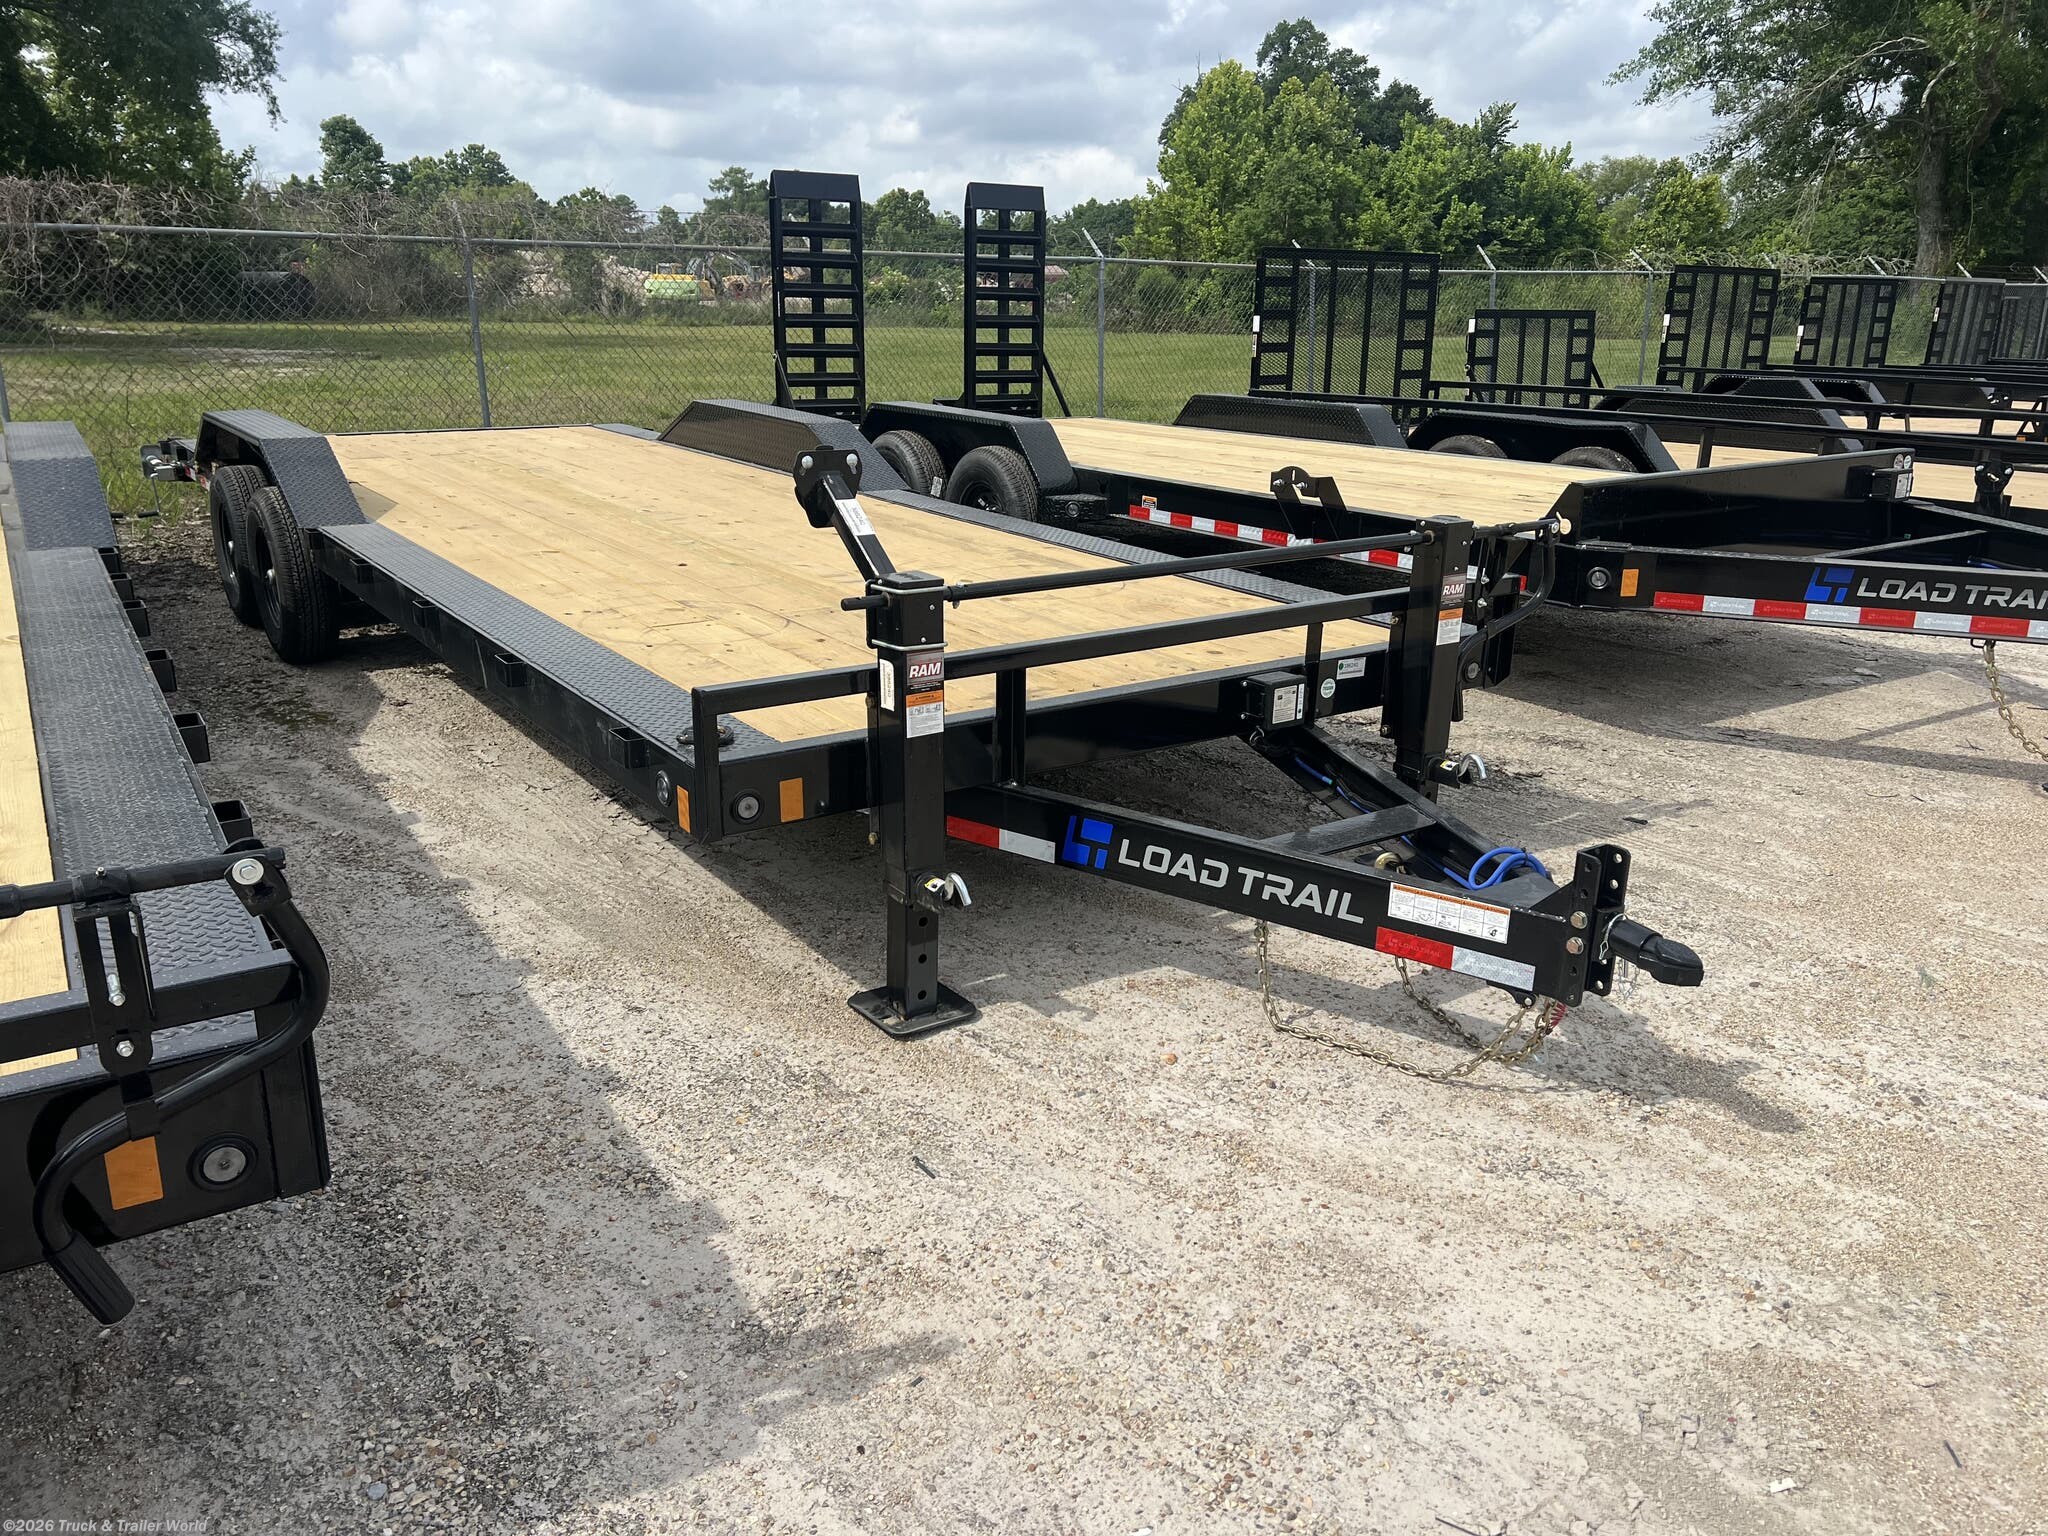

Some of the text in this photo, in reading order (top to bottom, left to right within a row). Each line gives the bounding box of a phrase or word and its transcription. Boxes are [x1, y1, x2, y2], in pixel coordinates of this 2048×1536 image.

[1442, 583, 1464, 596] RAM
[1857, 577, 2048, 610] LOAD TRAI
[909, 662, 942, 678] RAM
[1117, 838, 1229, 888] LOAD
[1238, 866, 1364, 924] TRAIL
